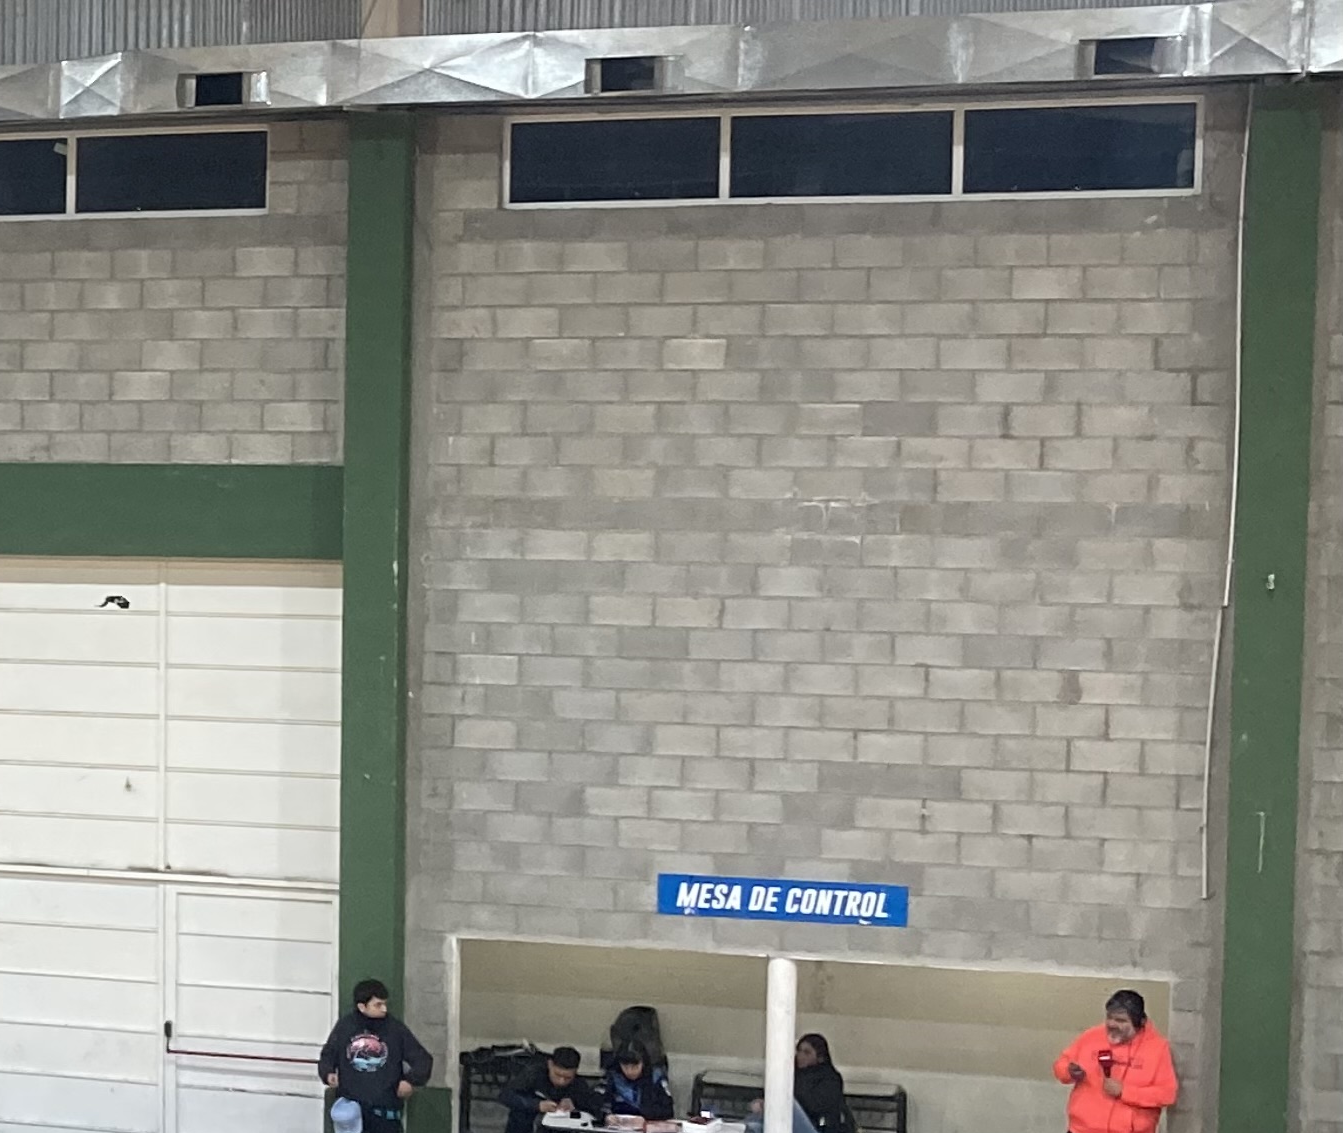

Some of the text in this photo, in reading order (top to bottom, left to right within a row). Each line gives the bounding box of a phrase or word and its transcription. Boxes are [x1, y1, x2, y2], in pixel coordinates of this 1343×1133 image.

[676, 882, 889, 918] MESA DE CONTROL
